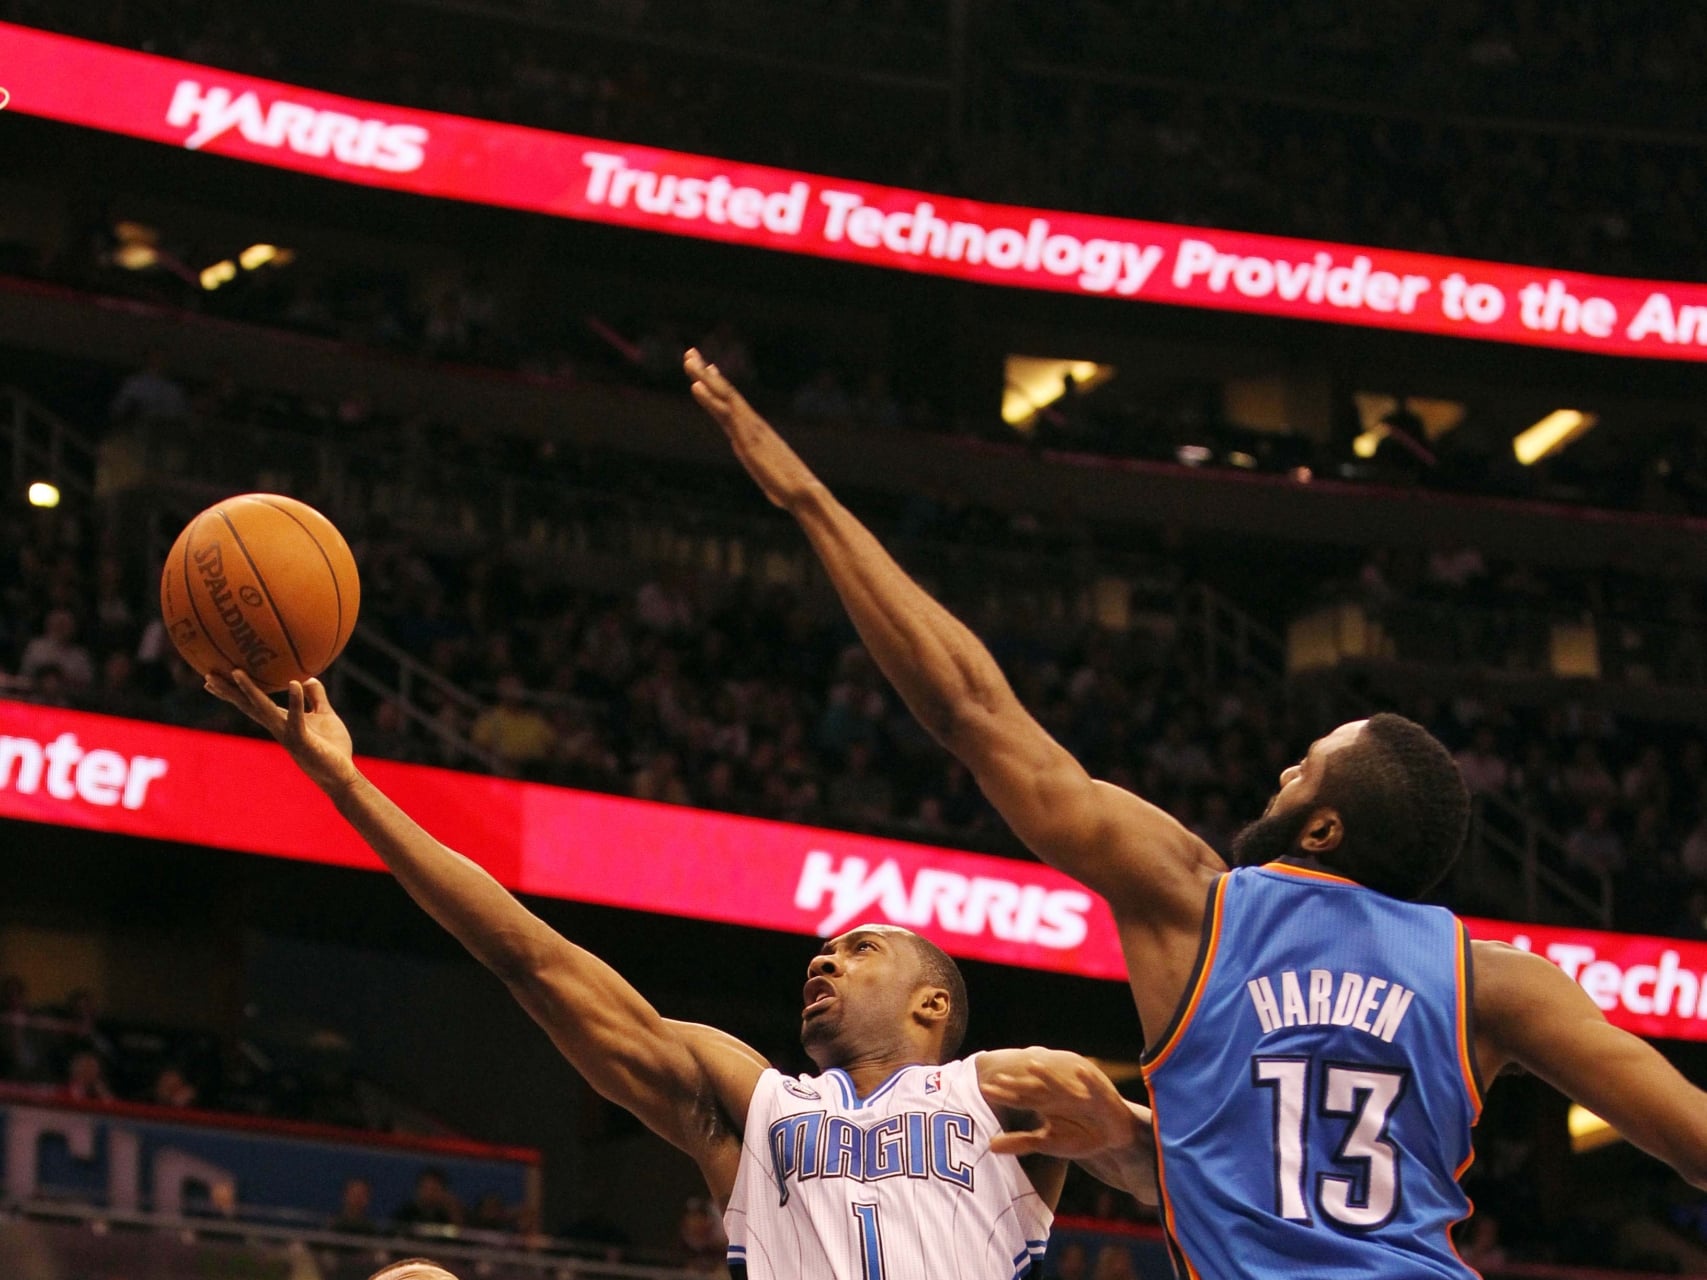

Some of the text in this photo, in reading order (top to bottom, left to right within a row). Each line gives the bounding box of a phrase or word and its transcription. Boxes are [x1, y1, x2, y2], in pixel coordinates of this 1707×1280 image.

[166, 80, 429, 173] HARRIS
[583, 152, 808, 235] Trusted
[821, 189, 1163, 295] Technology
[1173, 239, 1430, 314] Provider
[1440, 274, 1505, 324] to
[1520, 280, 1617, 337] the
[0, 733, 168, 810] nter
[795, 850, 1092, 960] HARRIS
[1247, 968, 1415, 1043] HARDEN
[767, 1109, 975, 1207] MAGIC
[1251, 1054, 1411, 1231] 13
